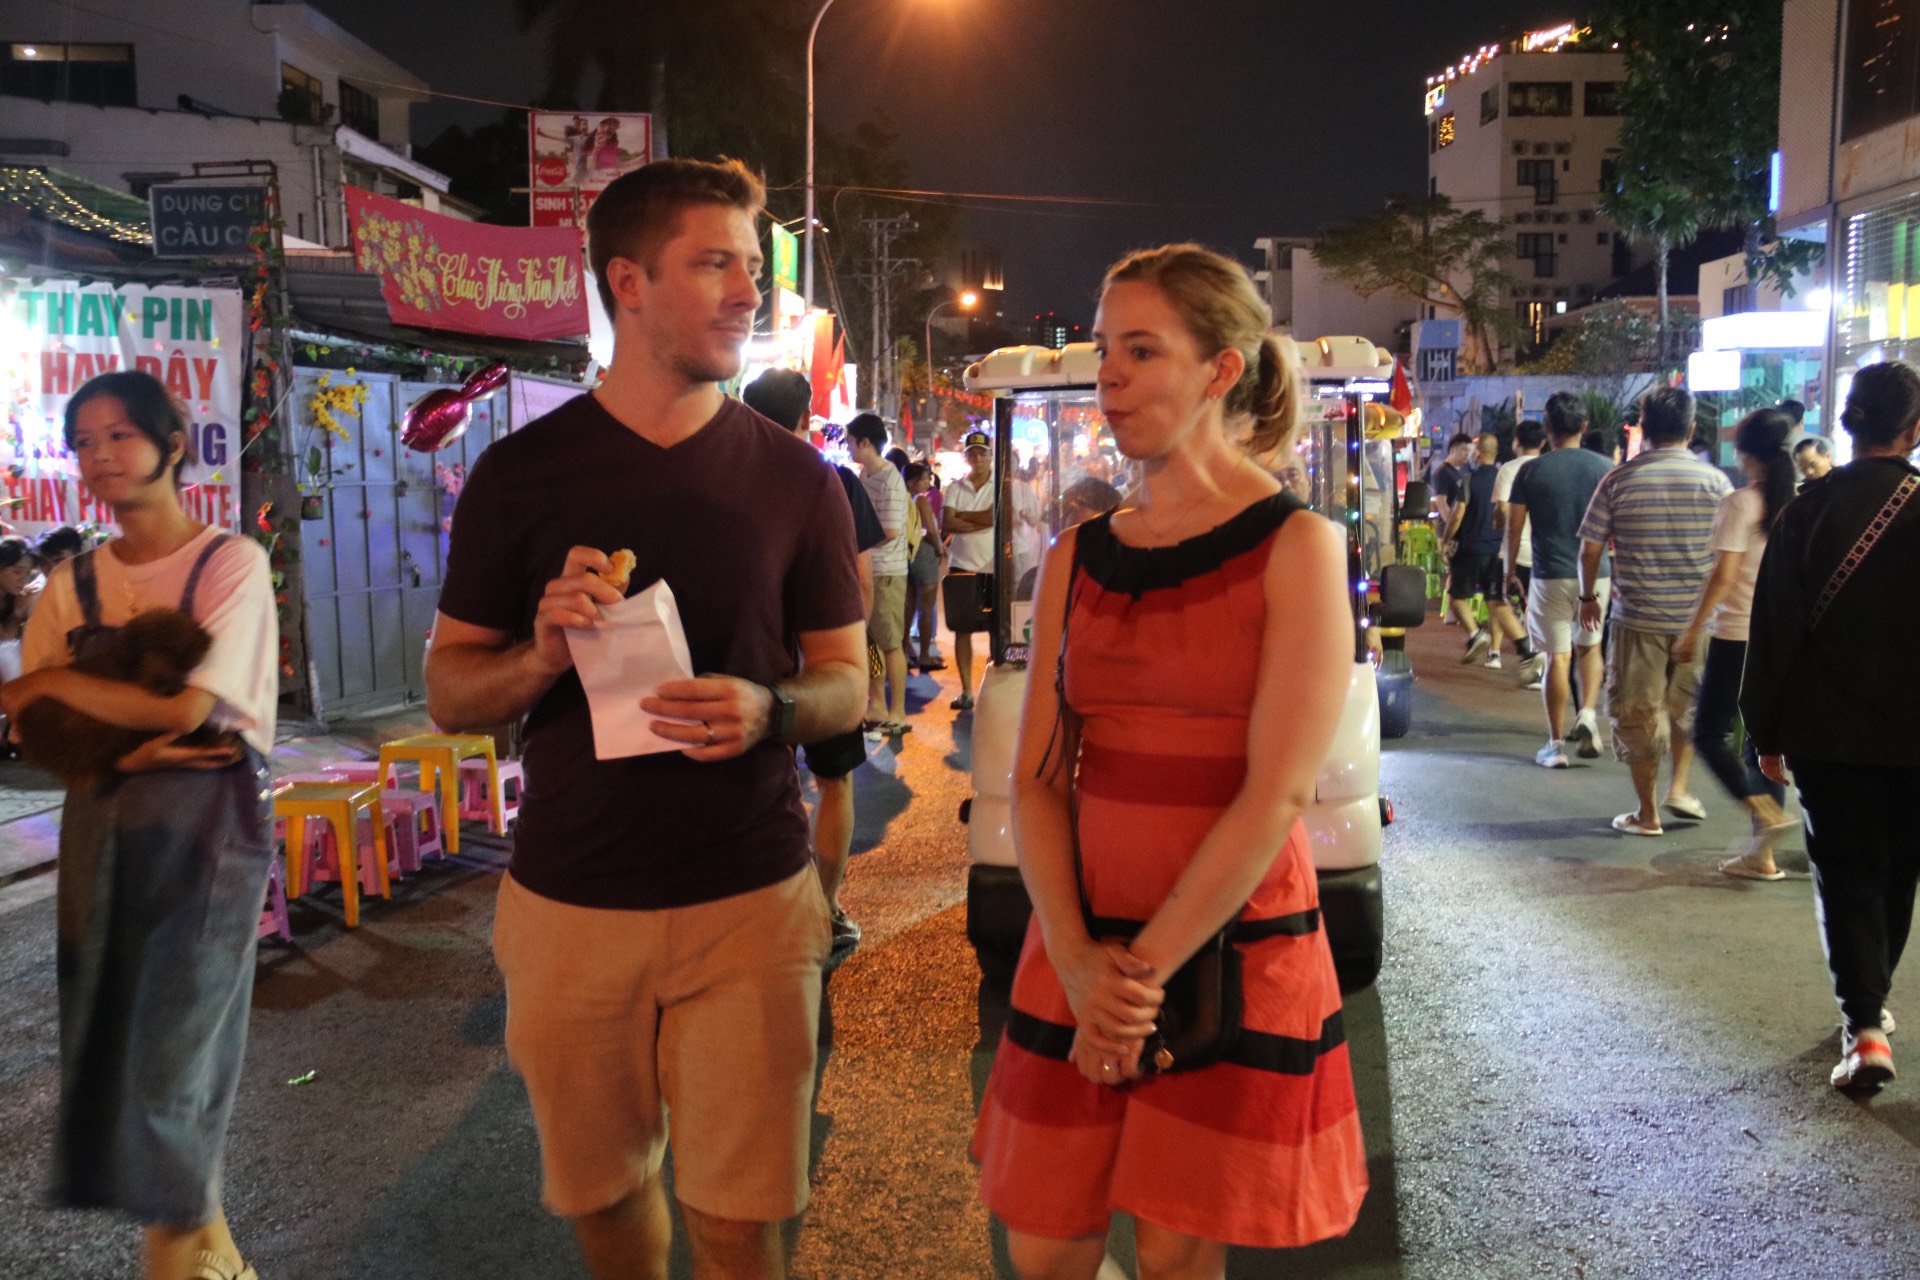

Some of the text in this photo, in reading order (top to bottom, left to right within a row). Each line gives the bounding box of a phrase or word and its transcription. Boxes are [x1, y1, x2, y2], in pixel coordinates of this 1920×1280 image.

[161, 194, 224, 216] DỤNG
[535, 196, 567, 212] SINH
[160, 221, 220, 247] CÂU
[437, 252, 485, 306] Chúc
[517, 257, 553, 304] Năm
[20, 291, 212, 341] THAY PIN
[4, 476, 66, 522] THAY
